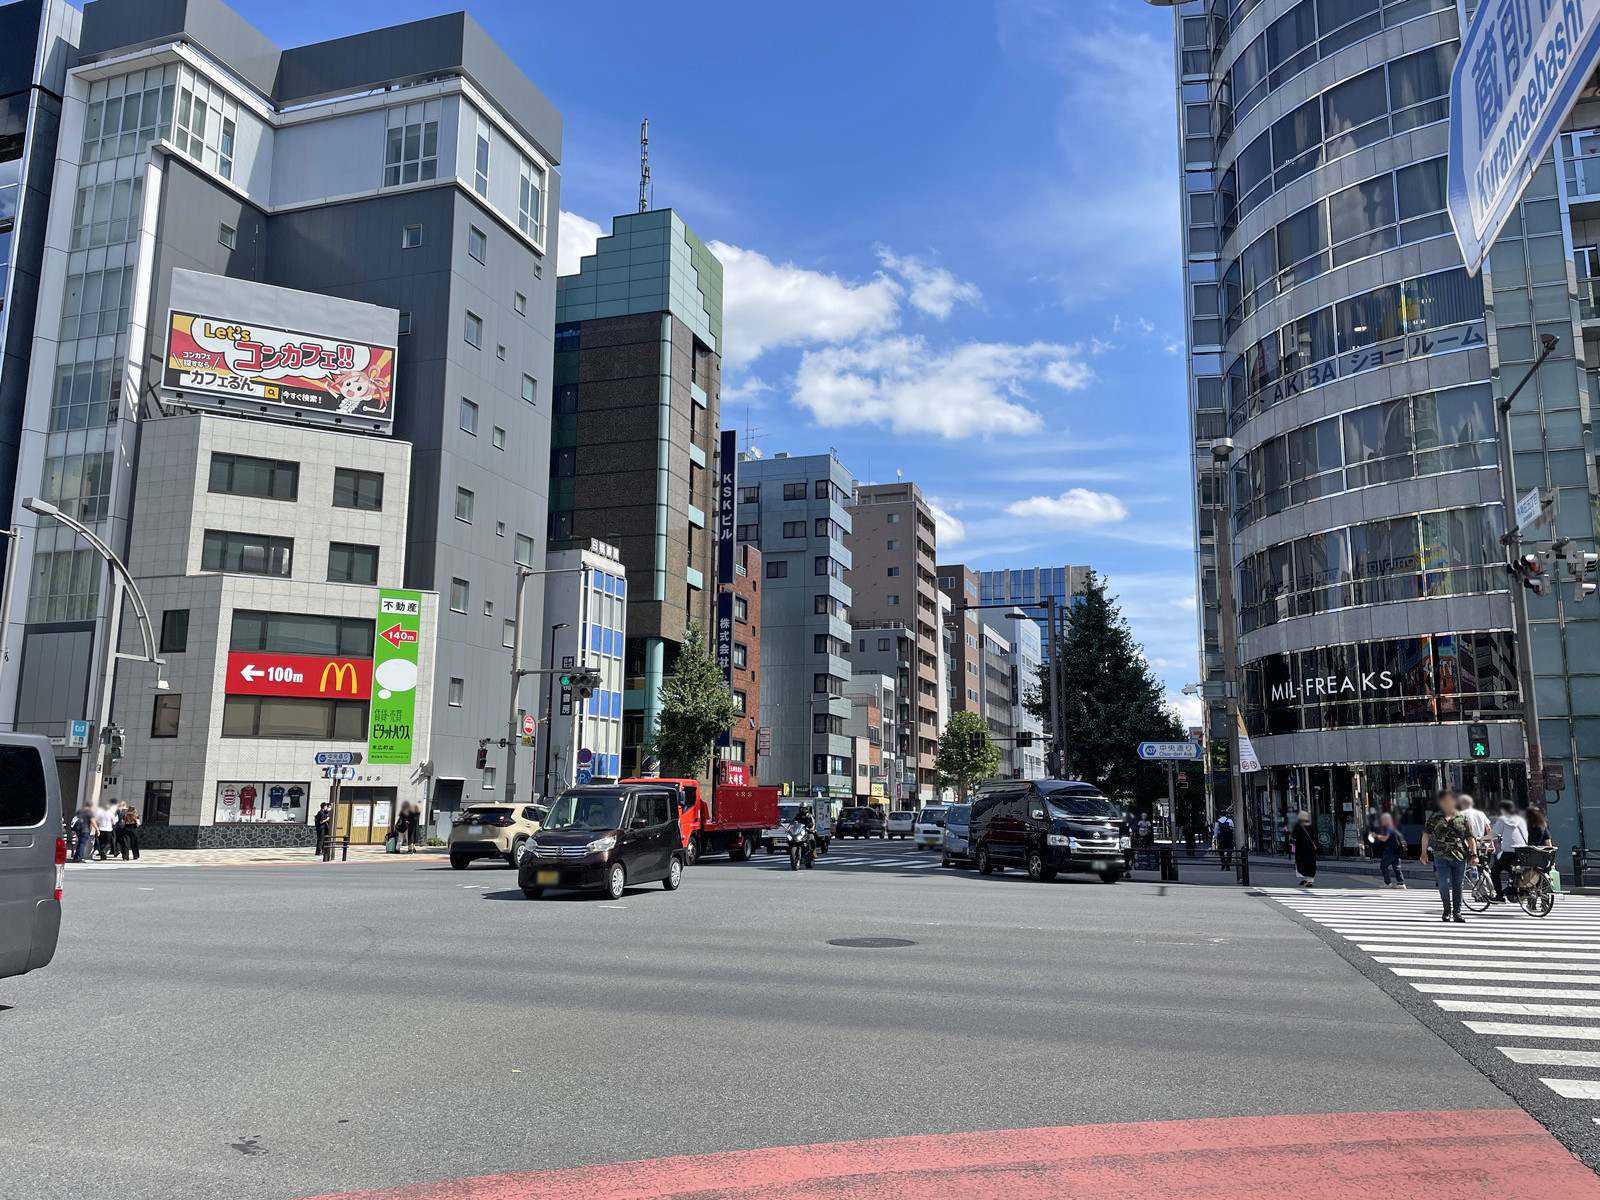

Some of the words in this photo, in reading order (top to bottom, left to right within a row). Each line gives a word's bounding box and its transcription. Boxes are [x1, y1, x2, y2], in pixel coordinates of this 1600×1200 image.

[204, 322, 251, 342] Let's
[182, 351, 212, 361] コンカフェ
[1351, 325, 1484, 374] ショールーム
[190, 369, 255, 393] カフェるん
[383, 600, 417, 613] 不動産
[388, 631, 415, 641] 140m
[267, 666, 304, 683] 100m
[1271, 670, 1394, 702] MIL-FREAKS
[373, 724, 410, 739] ピタットハウス
[1159, 744, 1192, 752] 中央通り
